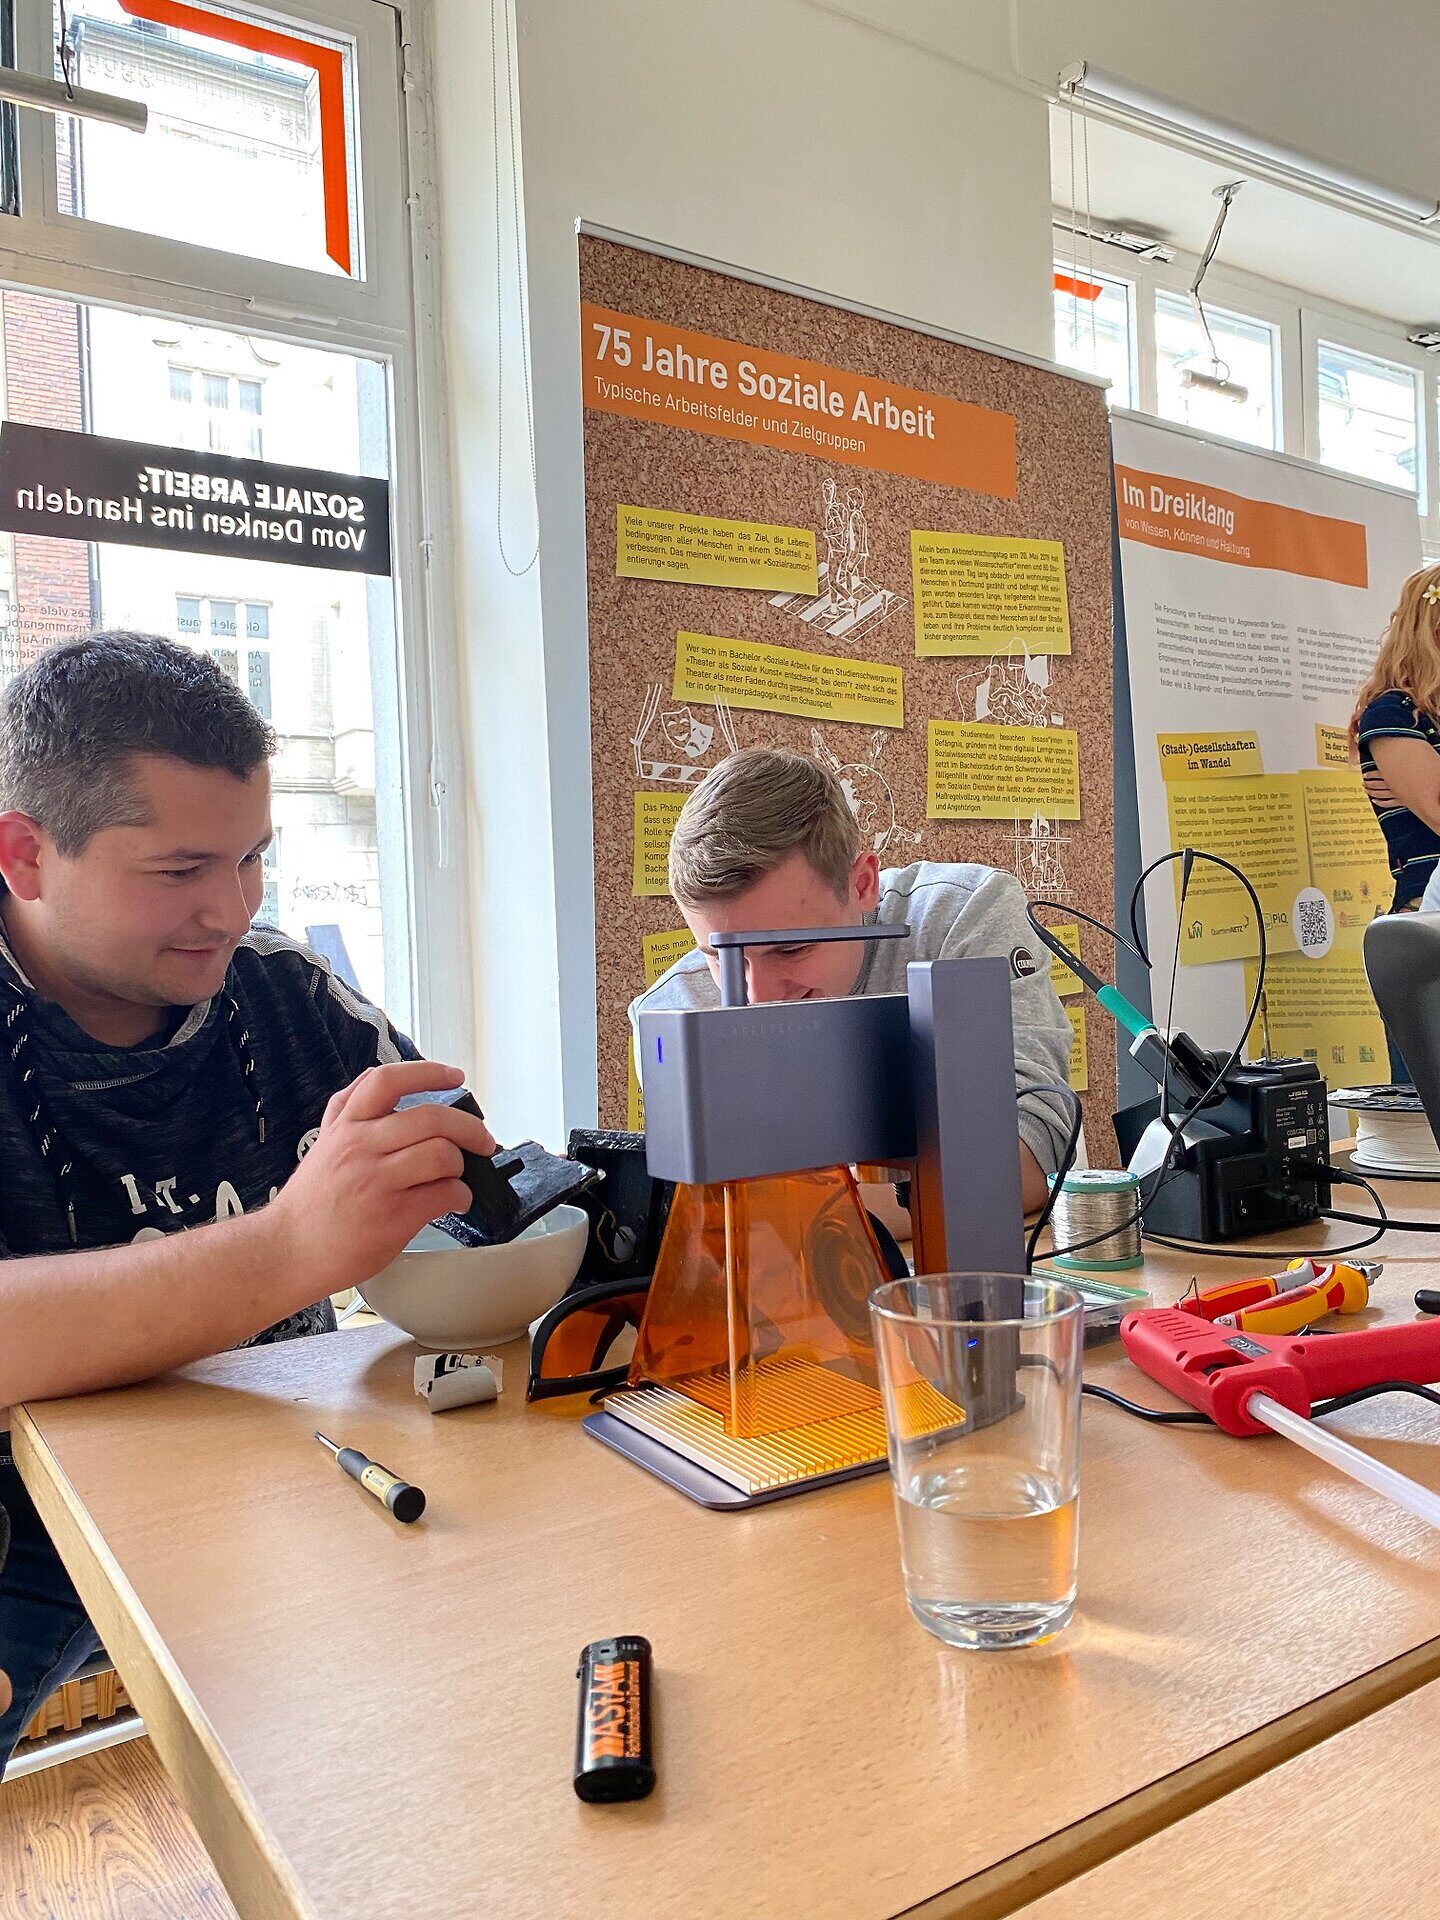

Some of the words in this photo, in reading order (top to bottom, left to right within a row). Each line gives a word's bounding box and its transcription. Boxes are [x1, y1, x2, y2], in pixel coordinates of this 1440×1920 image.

[593, 323, 632, 366] 75
[642, 336, 728, 390] Jahre
[738, 360, 844, 418] Soziale
[852, 390, 935, 440] Arbeit
[594, 376, 660, 406] Typische
[665, 393, 758, 428] Arbeitsfelder
[762, 417, 788, 434] und
[792, 420, 866, 452] Zielgruppen
[1122, 478, 1145, 510] Im
[1150, 486, 1234, 535] Dreiklang
[624, 516, 643, 526] Viele
[647, 521, 674, 530] unserer
[679, 523, 708, 536] Projekte
[713, 528, 734, 538] haben
[738, 531, 751, 540] das
[773, 536, 784, 544] die
[1125, 518, 1140, 528] von
[1140, 520, 1172, 540] Wissen,
[1174, 528, 1204, 545] Können
[1206, 538, 1218, 550] und
[1220, 539, 1250, 558] Haltung
[625, 529, 672, 545] bedingungen
[676, 535, 693, 545] aller
[697, 538, 733, 550] Menschen
[737, 543, 744, 552] in
[748, 544, 770, 555] einem
[670, 547, 684, 557] Das
[686, 549, 712, 560] meinen
[728, 556, 748, 564] wenn
[686, 643, 700, 653] Wer
[701, 646, 717, 656] sich
[718, 648, 728, 657] im
[729, 650, 761, 663] Bachelor
[822, 665, 834, 674] den
[718, 661, 729, 670] als
[731, 663, 758, 674] Soziale
[685, 668, 712, 679] Theater
[713, 672, 725, 681] als
[726, 674, 743, 684] roter
[745, 676, 766, 687] Faden
[685, 680, 696, 689] ter
[697, 682, 704, 690] in
[705, 683, 717, 692] der
[1162, 740, 1256, 757] (Stadt-)Gesellschaften
[1188, 760, 1199, 770] im
[1200, 757, 1232, 768] Wandel
[644, 803, 657, 812] Das
[644, 816, 660, 824] dass
[644, 828, 662, 836] Rolle
[651, 944, 670, 952] Muss
[672, 940, 688, 948] man
